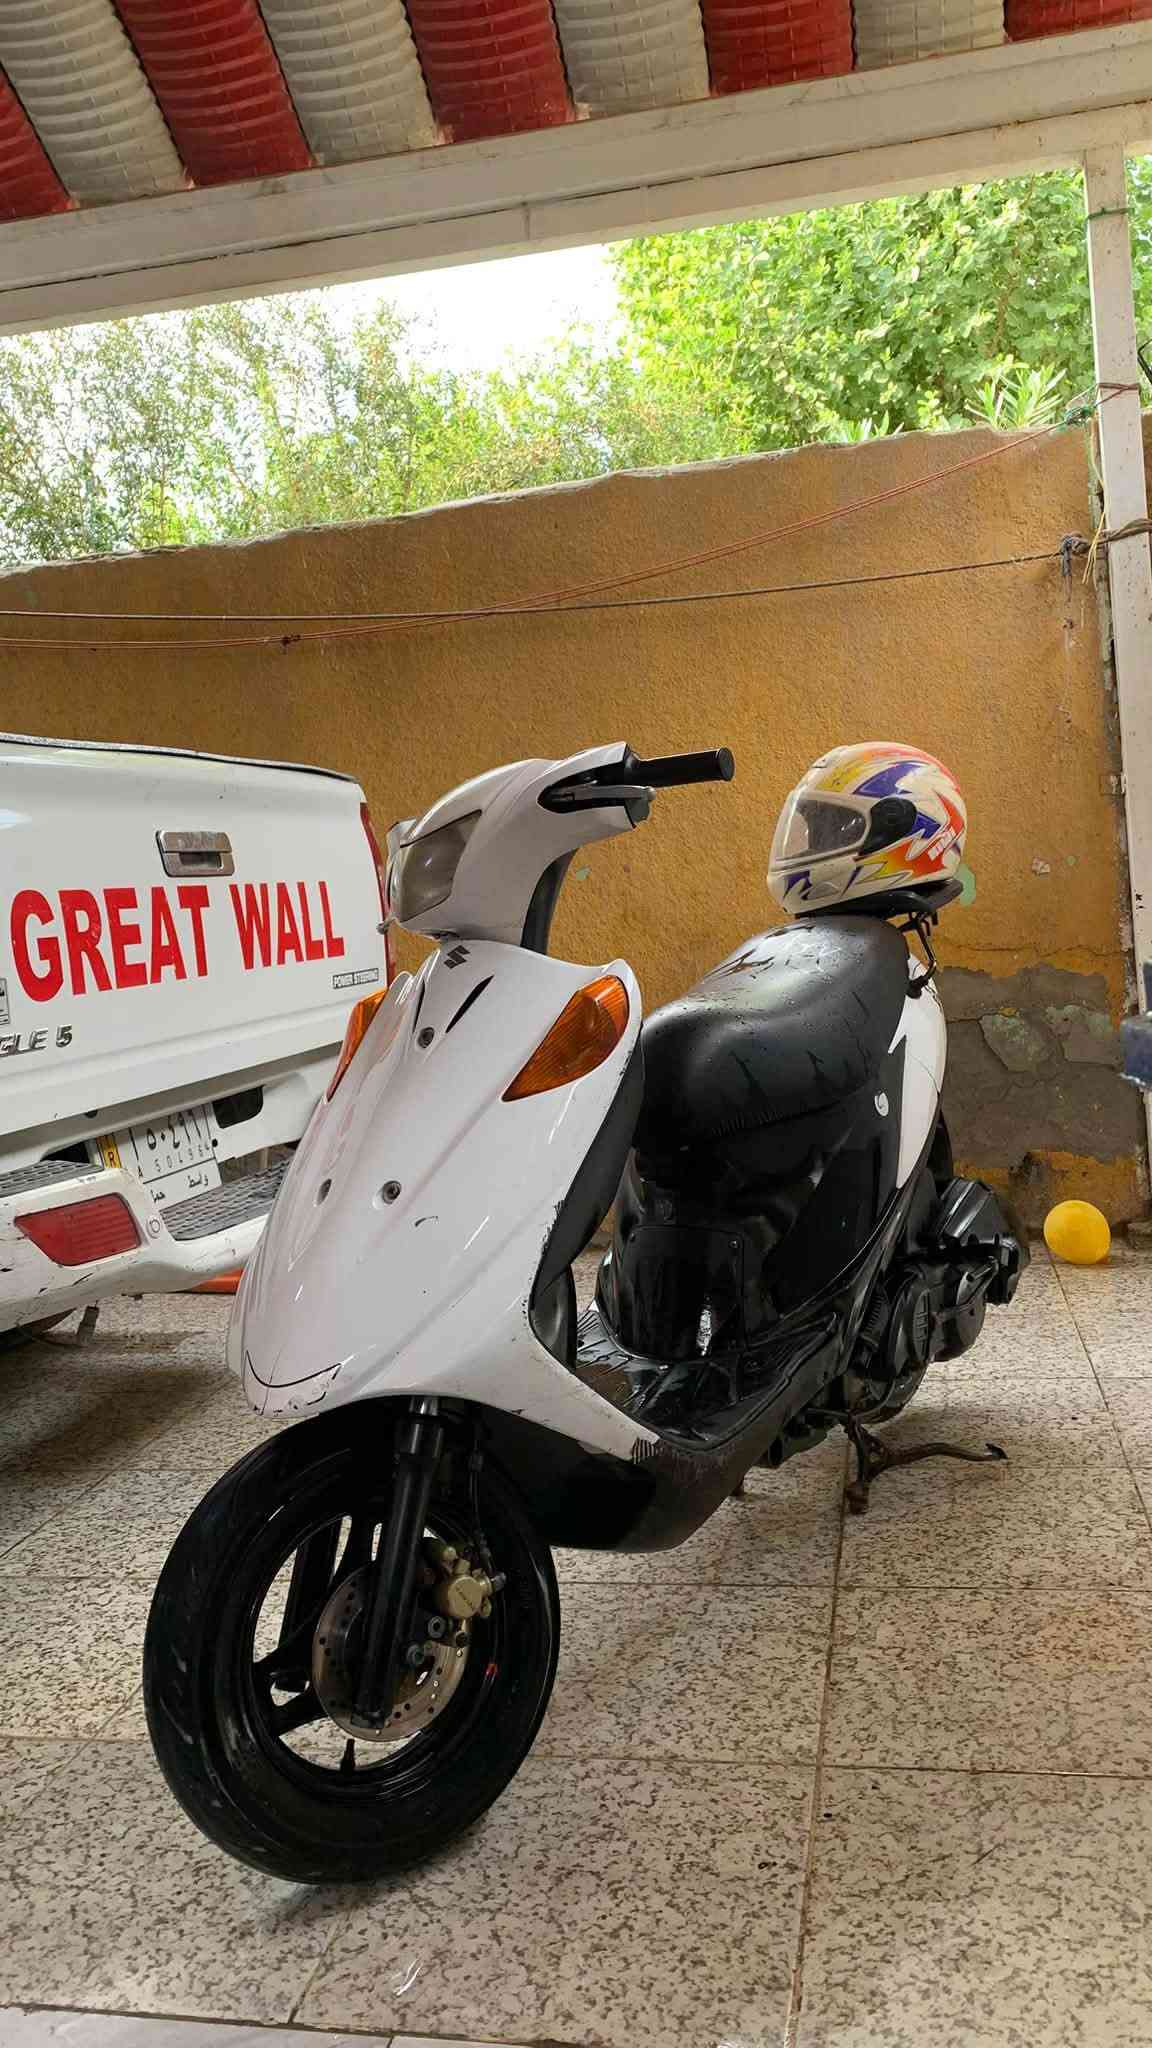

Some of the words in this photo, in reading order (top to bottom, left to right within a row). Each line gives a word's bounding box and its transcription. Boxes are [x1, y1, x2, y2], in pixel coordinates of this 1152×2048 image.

[10, 884, 210, 1002] GREAT
[229, 881, 345, 970] WALL
[55, 1024, 73, 1048] 5
